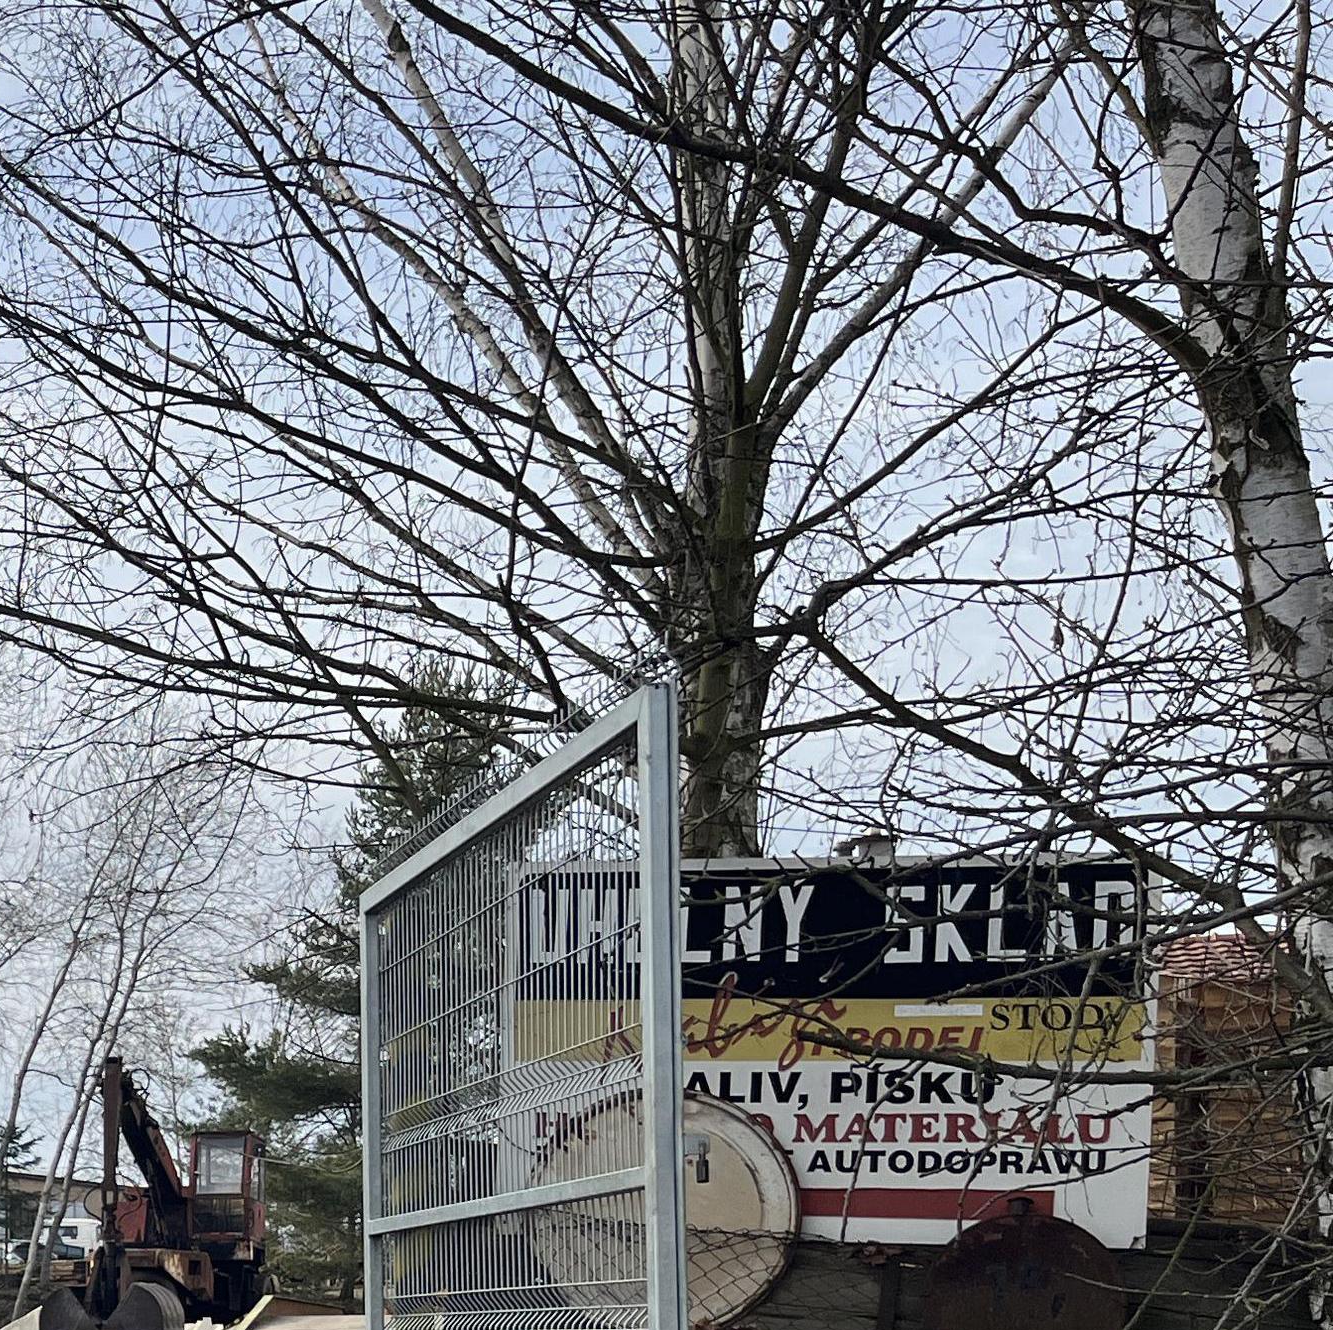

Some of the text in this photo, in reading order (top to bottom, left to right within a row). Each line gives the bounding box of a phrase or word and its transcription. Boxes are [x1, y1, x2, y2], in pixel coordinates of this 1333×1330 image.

[883, 881, 1136, 963] SKLAD
[990, 1003, 1104, 1031] STOD
[684, 1071, 809, 1111] ALIV,
[793, 1105, 1112, 1144] MATERIÁLU
[807, 1149, 1108, 1175] AUTODOPRAVU
